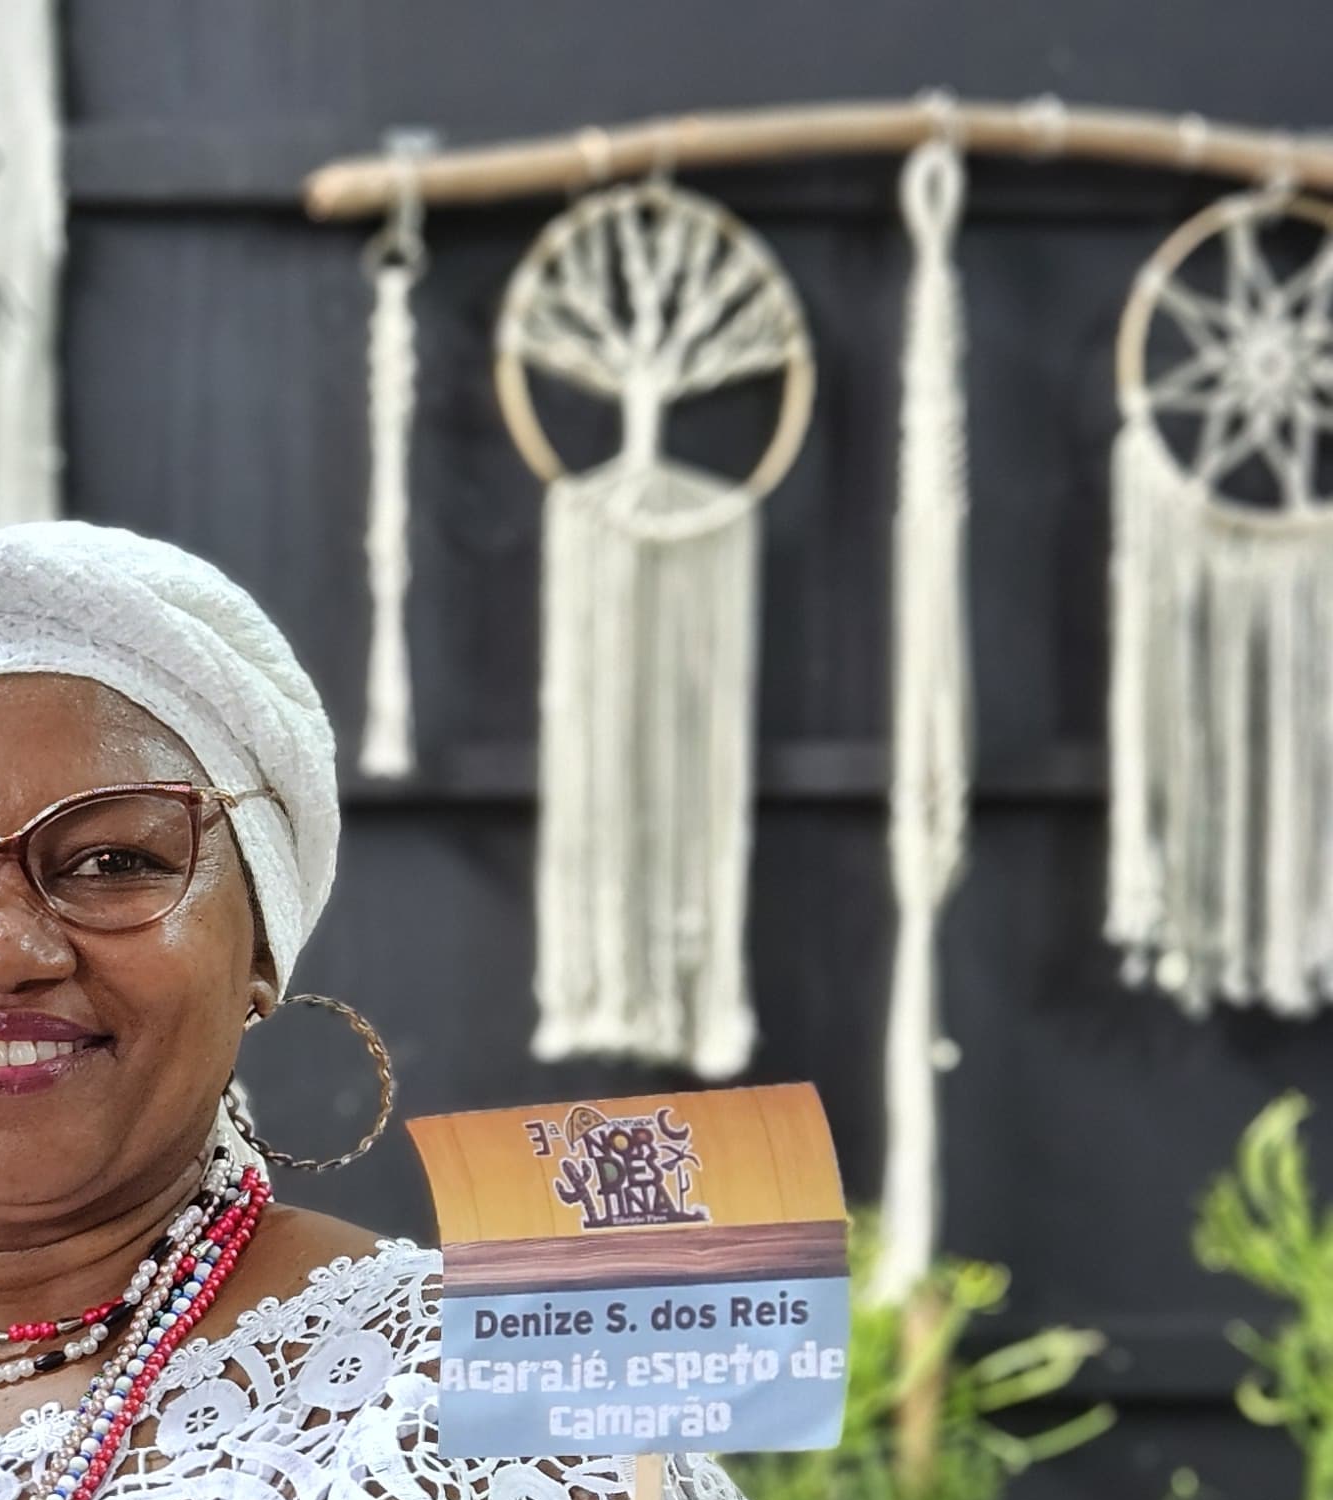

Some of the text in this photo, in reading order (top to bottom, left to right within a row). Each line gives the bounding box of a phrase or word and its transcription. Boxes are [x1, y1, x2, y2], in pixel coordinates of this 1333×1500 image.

[475, 1291, 810, 1339] Denize S. dos Reis
[442, 1341, 846, 1394] Acarajé, espeto de
[549, 1396, 732, 1441] camarão
